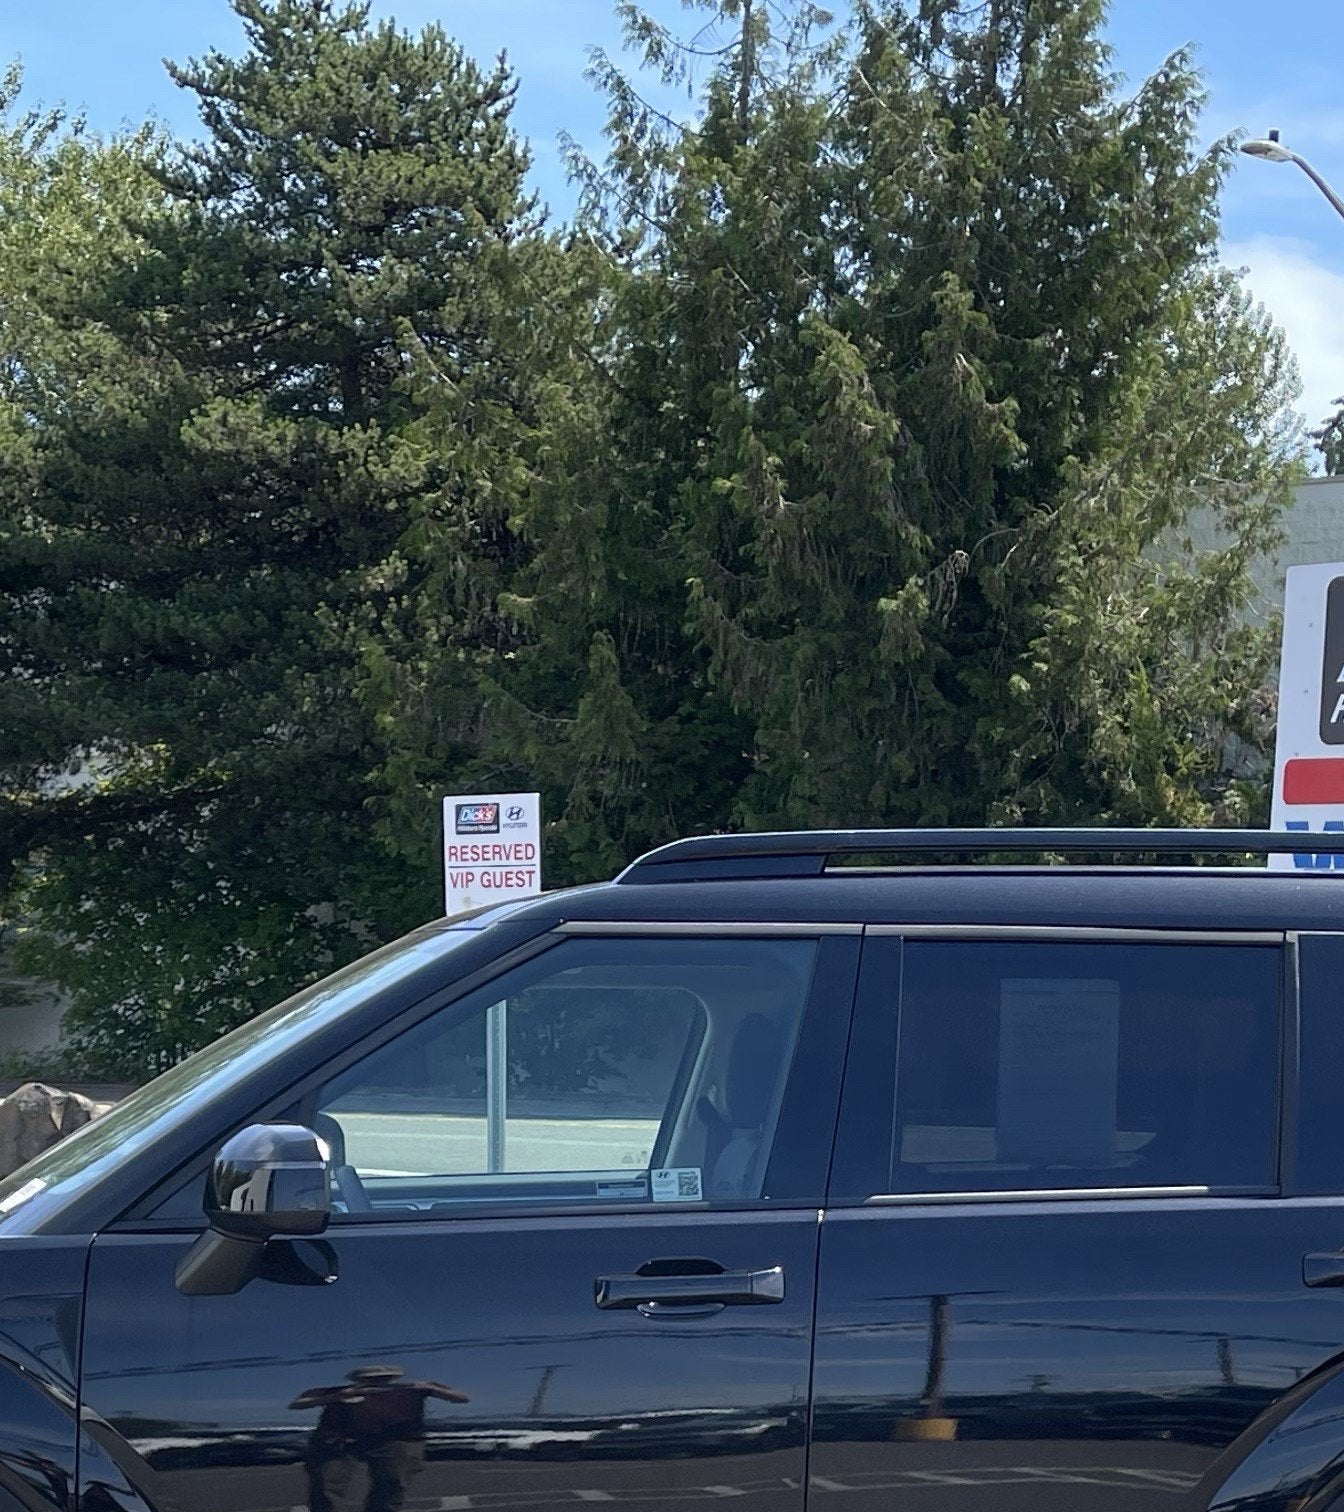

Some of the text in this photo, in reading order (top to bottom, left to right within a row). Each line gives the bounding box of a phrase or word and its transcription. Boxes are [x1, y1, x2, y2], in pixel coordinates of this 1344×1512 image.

[448, 843, 536, 862] RESERVED
[450, 870, 536, 888] VIP GUEST
